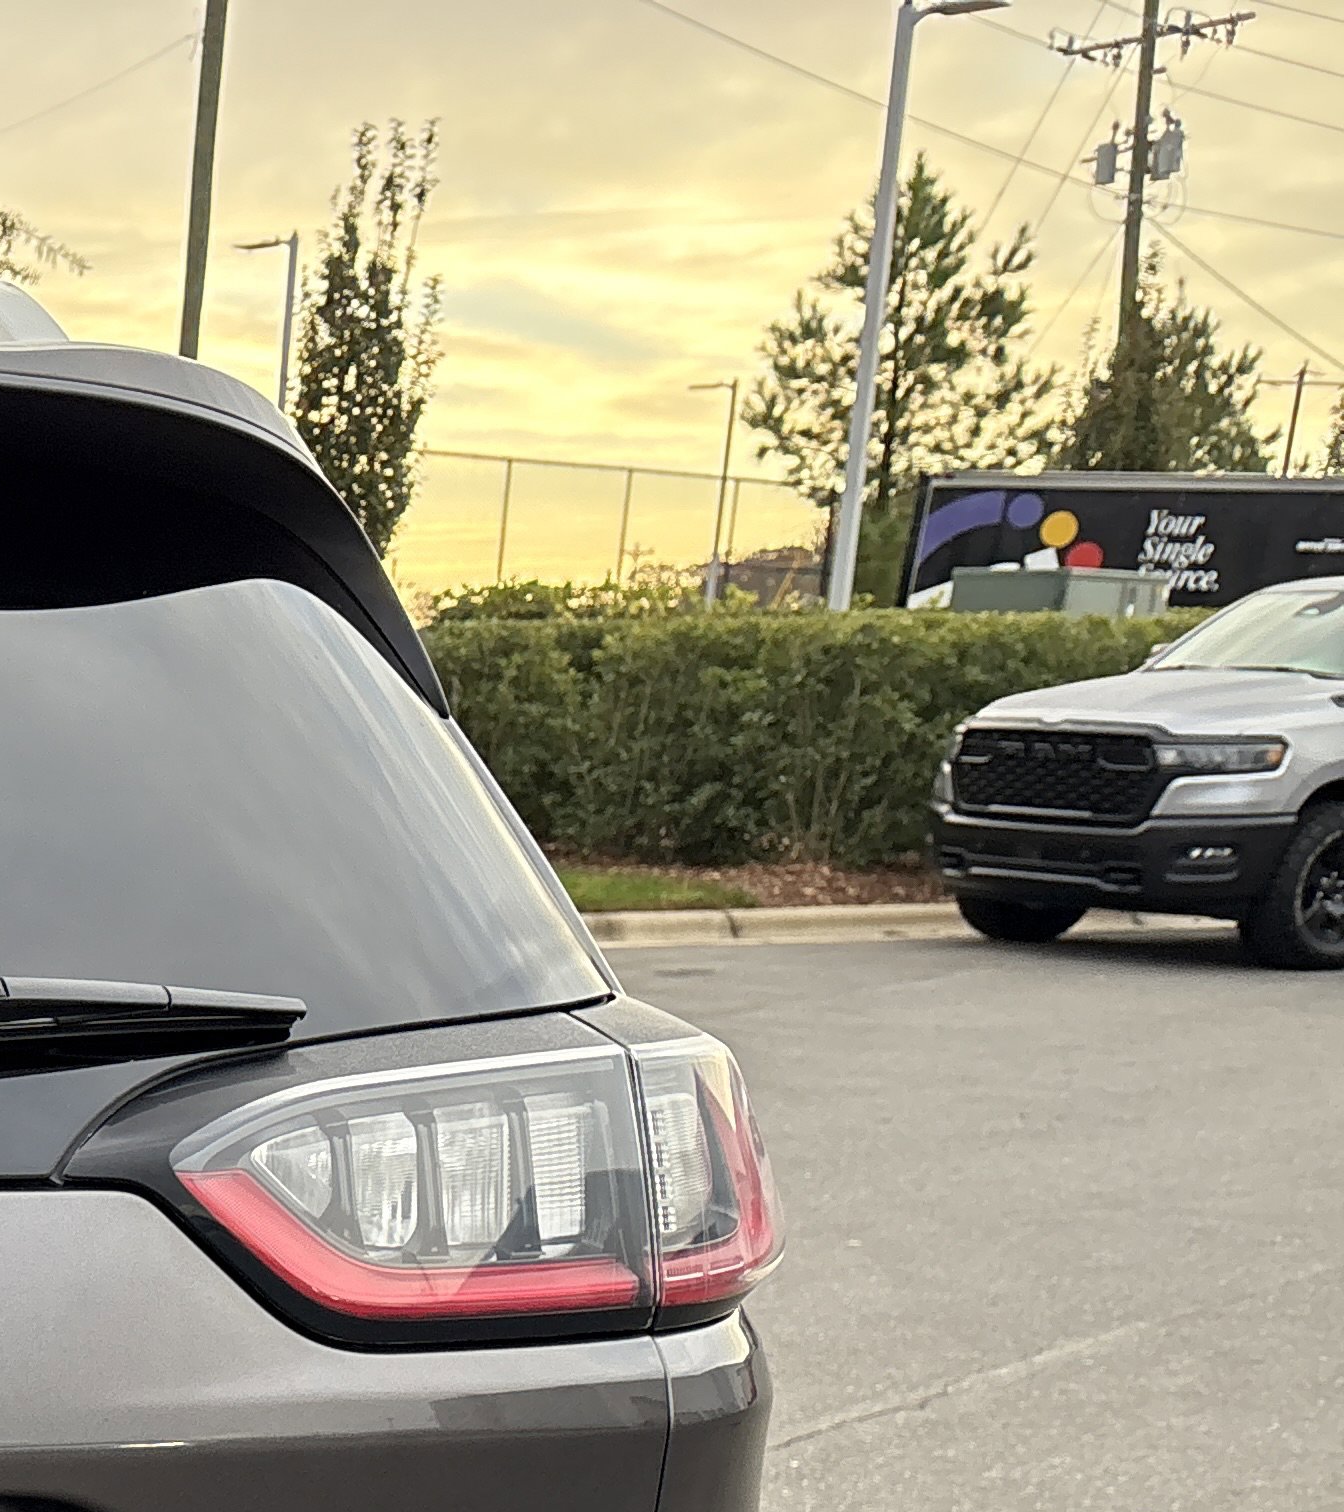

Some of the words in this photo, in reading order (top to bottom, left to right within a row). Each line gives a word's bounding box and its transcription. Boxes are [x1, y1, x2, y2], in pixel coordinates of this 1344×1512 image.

[1146, 509, 1206, 536] Your
[1137, 535, 1215, 569] Single
[1138, 563, 1220, 592] urce.
